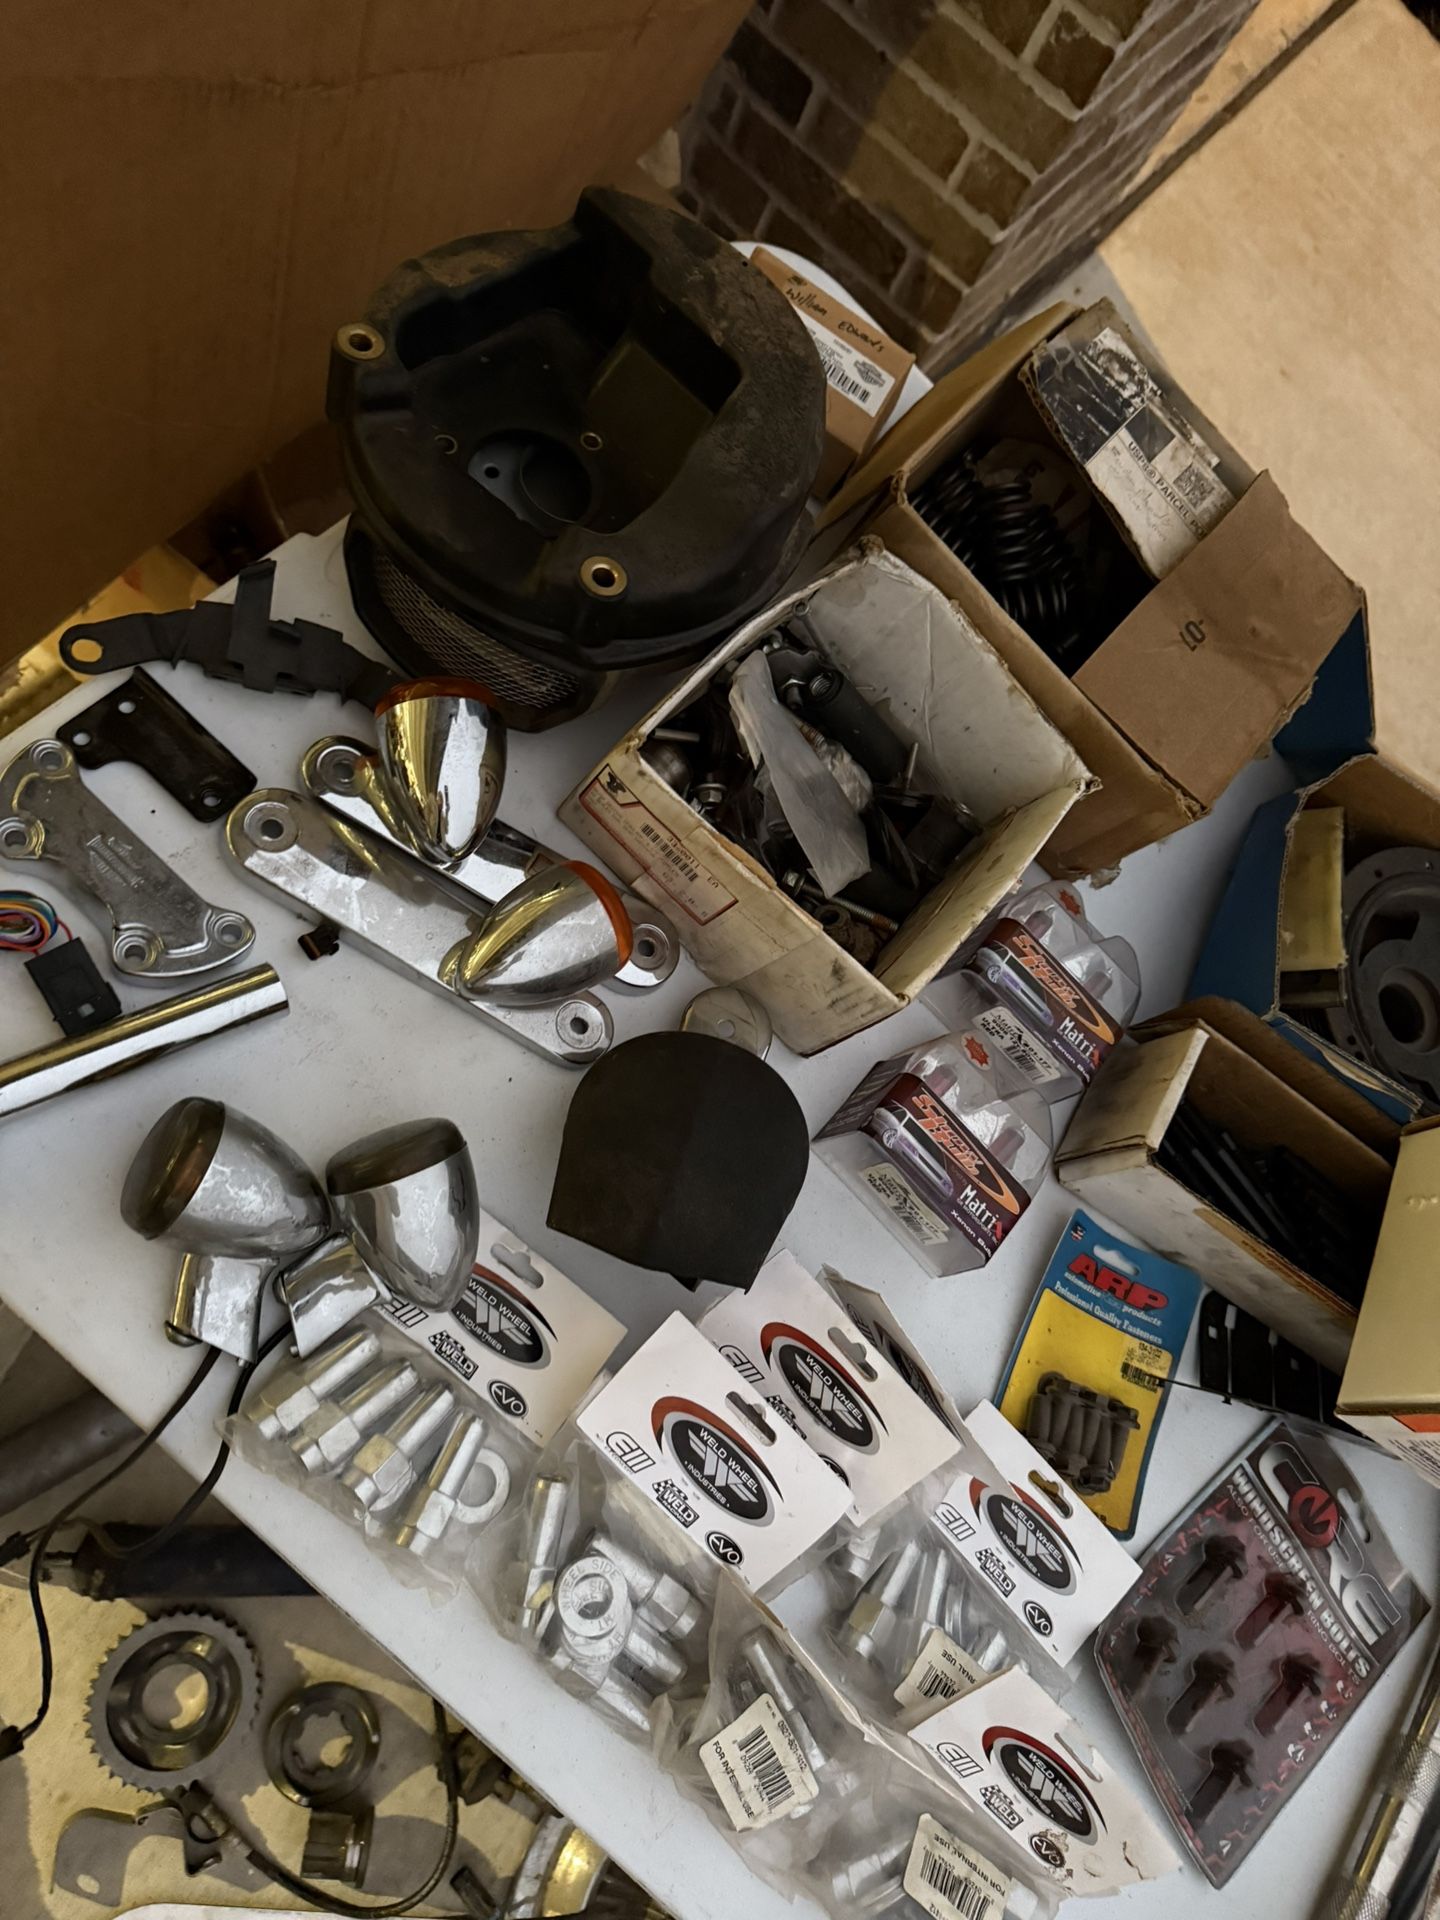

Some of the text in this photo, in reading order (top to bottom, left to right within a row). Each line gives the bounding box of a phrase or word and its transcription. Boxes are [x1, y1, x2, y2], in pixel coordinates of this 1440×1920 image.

[469, 1278, 531, 1337] WELD WHEEL
[1067, 1252, 1169, 1311] ARP
[460, 1313, 503, 1350] INDUSTRIES
[1054, 1280, 1093, 1312] Professional
[1094, 1304, 1122, 1329] Quality
[1122, 1318, 1163, 1345] Fasteners
[1122, 1305, 1162, 1327] products
[441, 1341, 476, 1374] WELD
[794, 1382, 834, 1428] INDUSTRIES
[806, 1354, 833, 1386] WELD
[832, 1385, 864, 1423] WHEEL
[686, 1463, 728, 1506] INDUSTRIES
[699, 1428, 760, 1495] WELD WHEEL
[662, 1488, 697, 1523] WELD
[1226, 1484, 1249, 1516] ALSO
[1248, 1517, 1266, 1546] FOR
[1002, 1534, 1037, 1573] INDUSTRIES
[1011, 1502, 1063, 1563] WELD WHEEL
[591, 1558, 621, 1579] SIDE
[984, 1559, 1014, 1593] WELD
[1232, 1467, 1371, 1680] WINDSCREEN BOLTS
[941, 1650, 957, 1662] USE
[712, 1740, 755, 1818] FOR INTERNAL USE
[1029, 1752, 1083, 1814] WELD WHEEL
[989, 1795, 1022, 1827] WELD
[934, 1833, 1006, 1897] FOR INTERNAL USE
